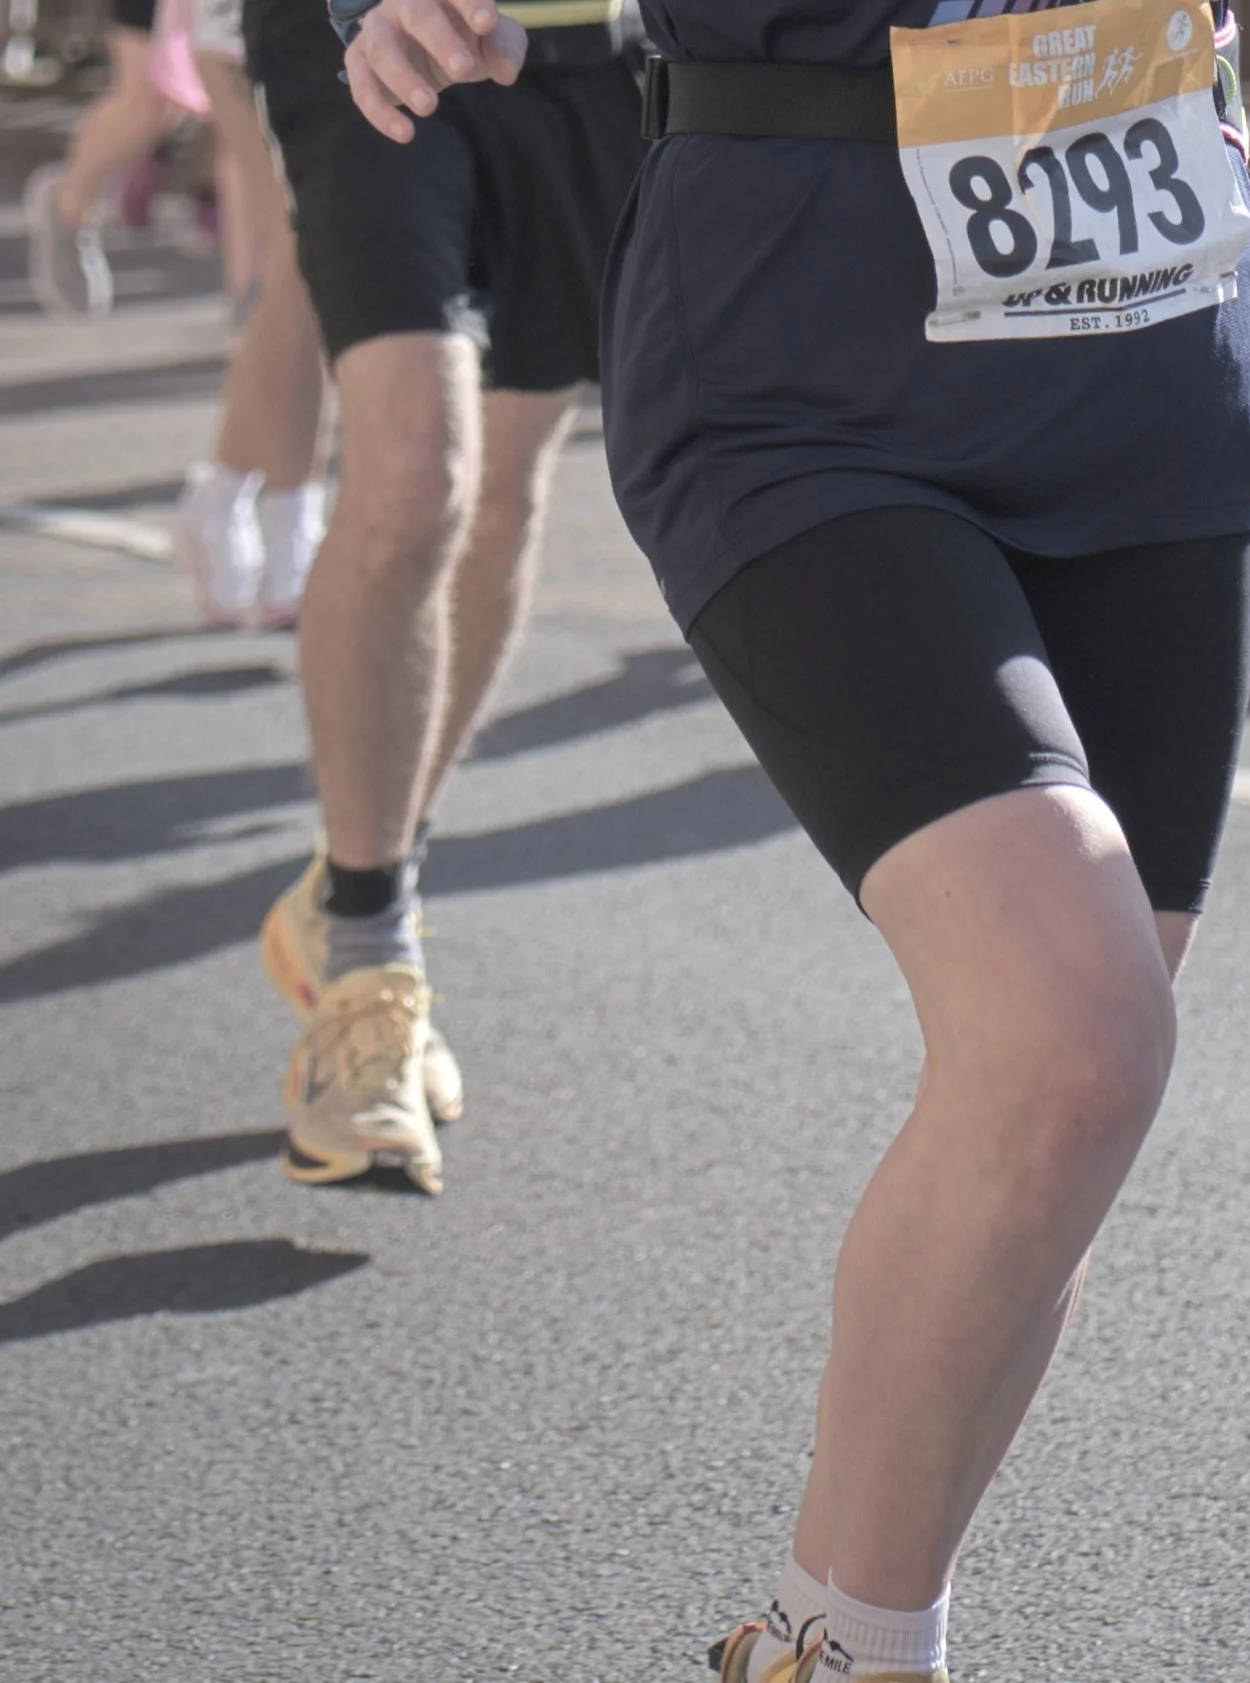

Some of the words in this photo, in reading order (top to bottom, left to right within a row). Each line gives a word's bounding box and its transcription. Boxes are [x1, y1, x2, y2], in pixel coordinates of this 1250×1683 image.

[1032, 23, 1096, 59] GREAT
[943, 66, 995, 87] AEPG
[1009, 52, 1097, 88] EASTERN
[1058, 79, 1095, 109] RUN
[949, 118, 1206, 278] 8293
[1044, 281, 1072, 307] &
[1075, 262, 1194, 305] RUNNING
